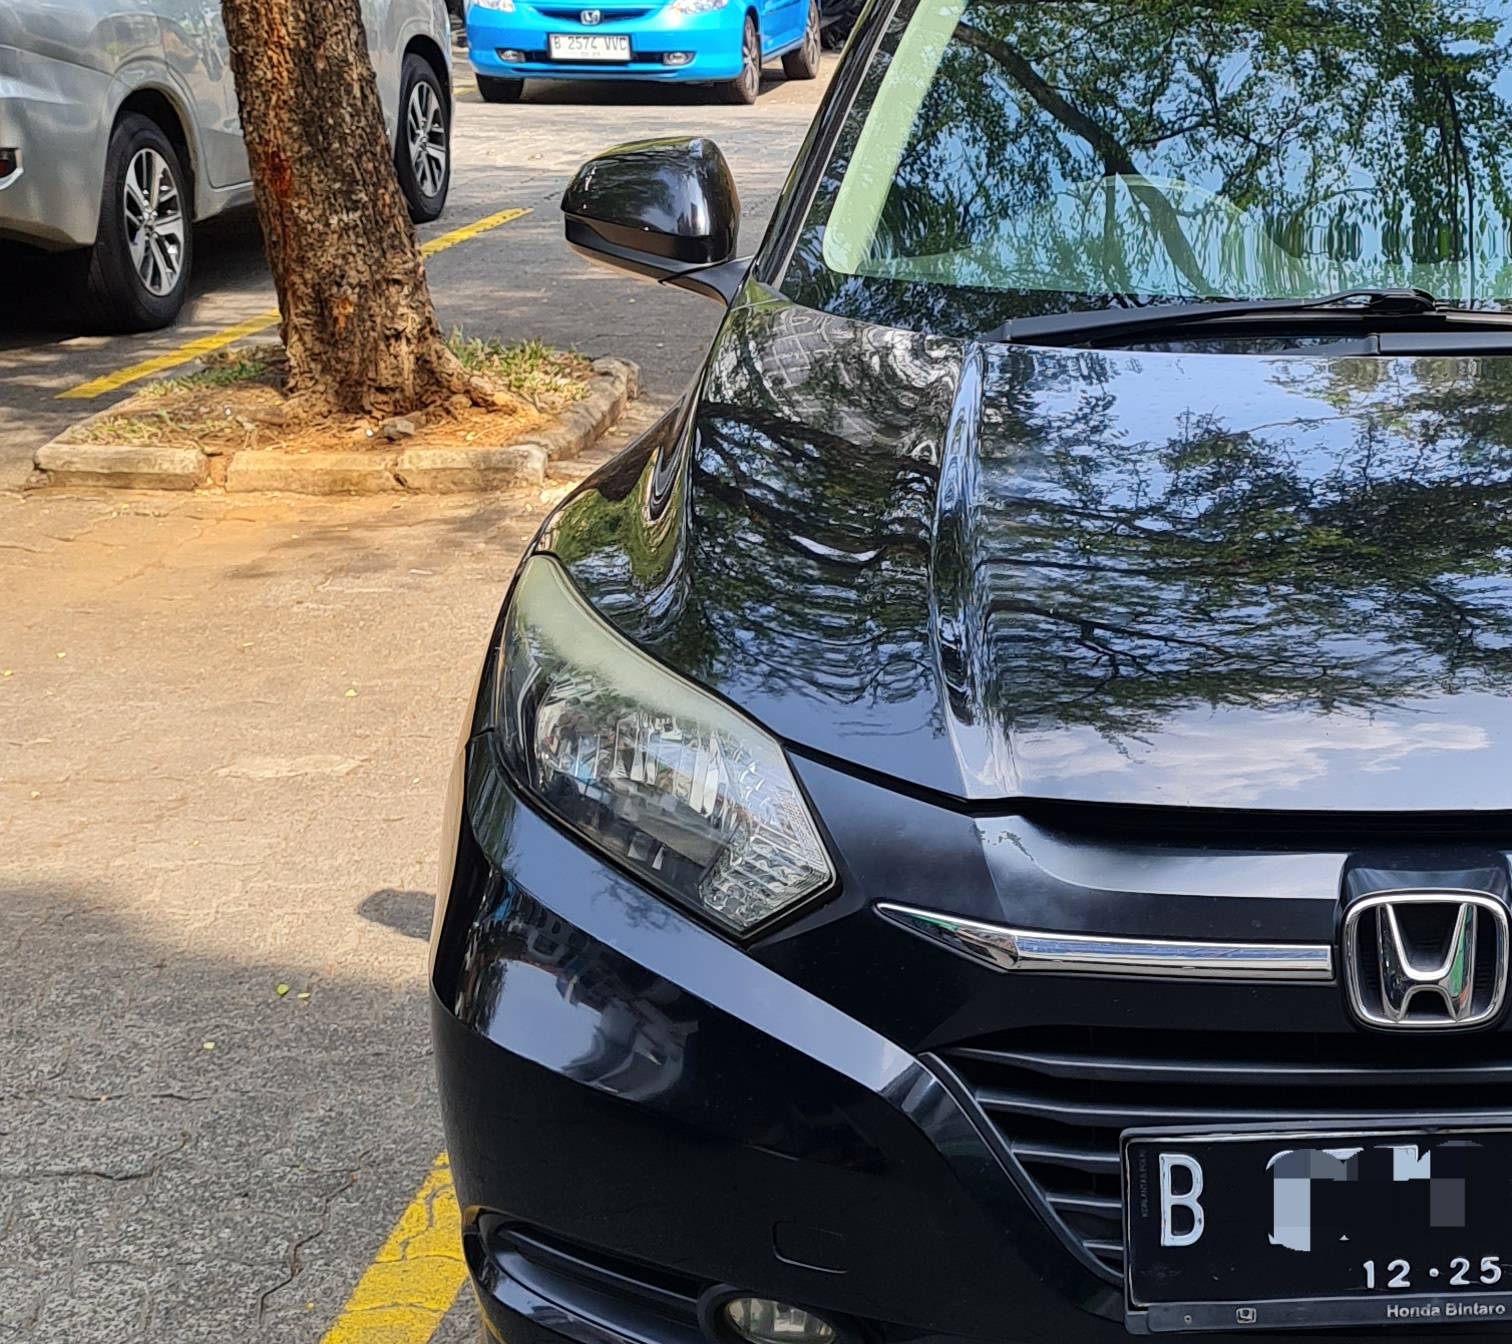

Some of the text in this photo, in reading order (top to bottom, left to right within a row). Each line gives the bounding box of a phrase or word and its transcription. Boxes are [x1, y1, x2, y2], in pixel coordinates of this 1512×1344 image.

[1159, 1153, 1204, 1246] B
[1386, 1304, 1441, 1319] Honda
[1445, 1300, 1506, 1317] Bintaro
